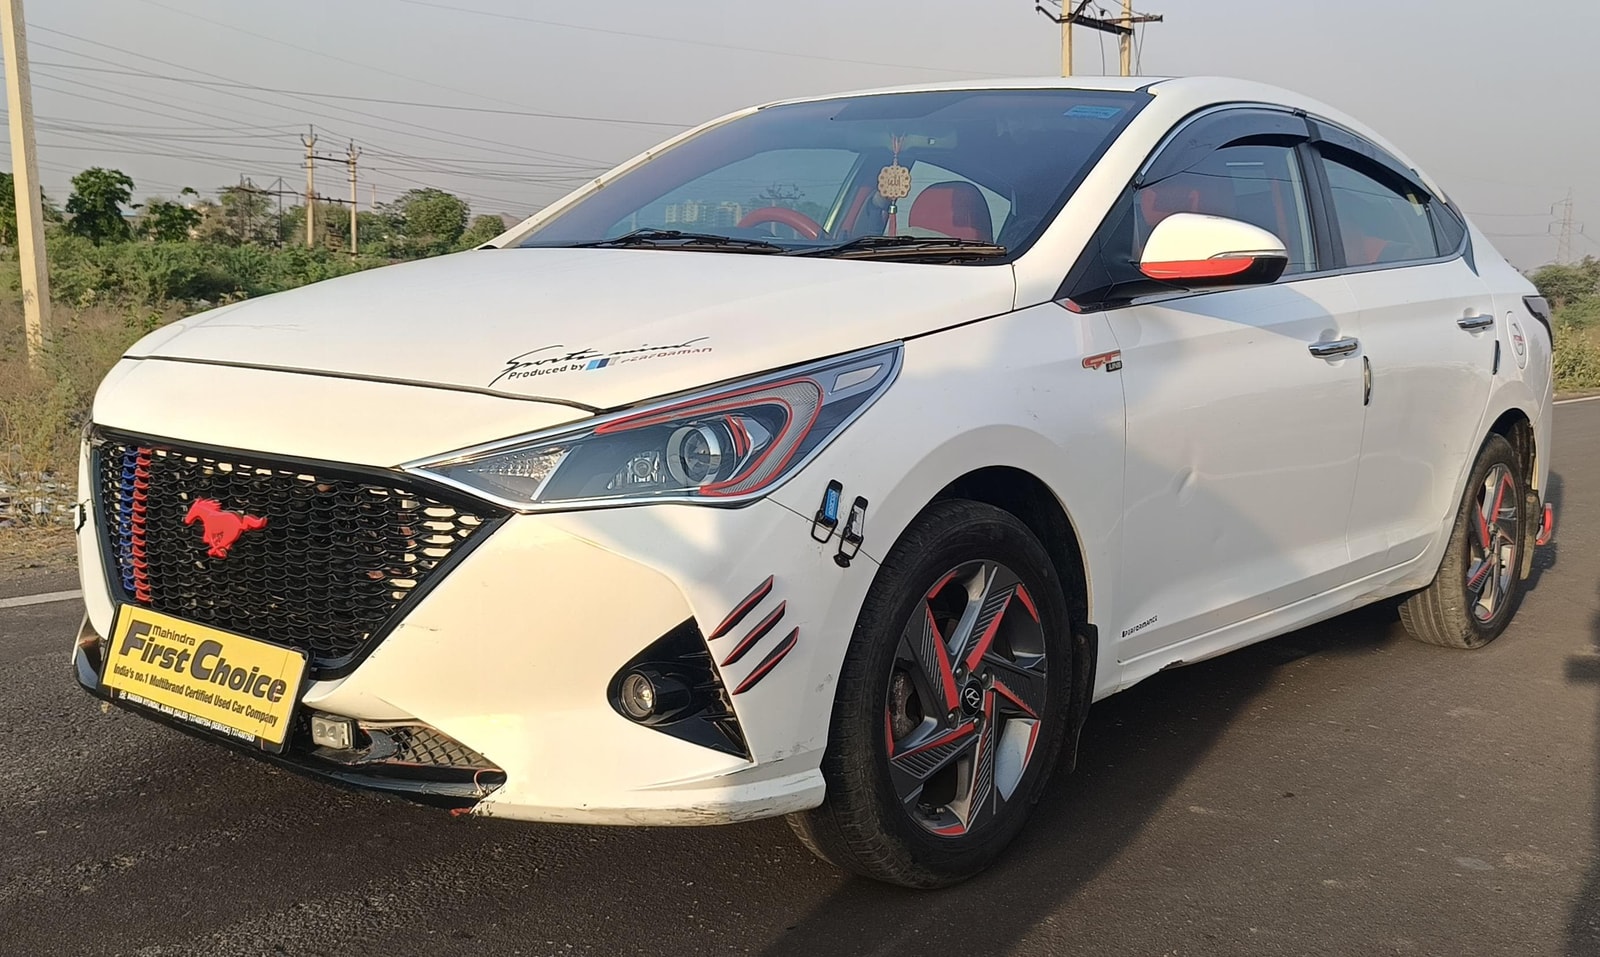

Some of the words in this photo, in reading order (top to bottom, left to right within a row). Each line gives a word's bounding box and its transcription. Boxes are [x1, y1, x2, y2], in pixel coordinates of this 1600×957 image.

[508, 364, 568, 380] Produced
[570, 363, 586, 371] by
[152, 625, 195, 646] Mahindra
[119, 619, 191, 673] First
[190, 640, 287, 703] Choice
[113, 663, 135, 679] India's
[135, 672, 149, 683] no.1
[149, 674, 185, 695] Multibrand
[184, 685, 214, 704] Certified
[213, 694, 232, 710] Used
[231, 700, 245, 714] Car
[245, 705, 278, 727] Company
